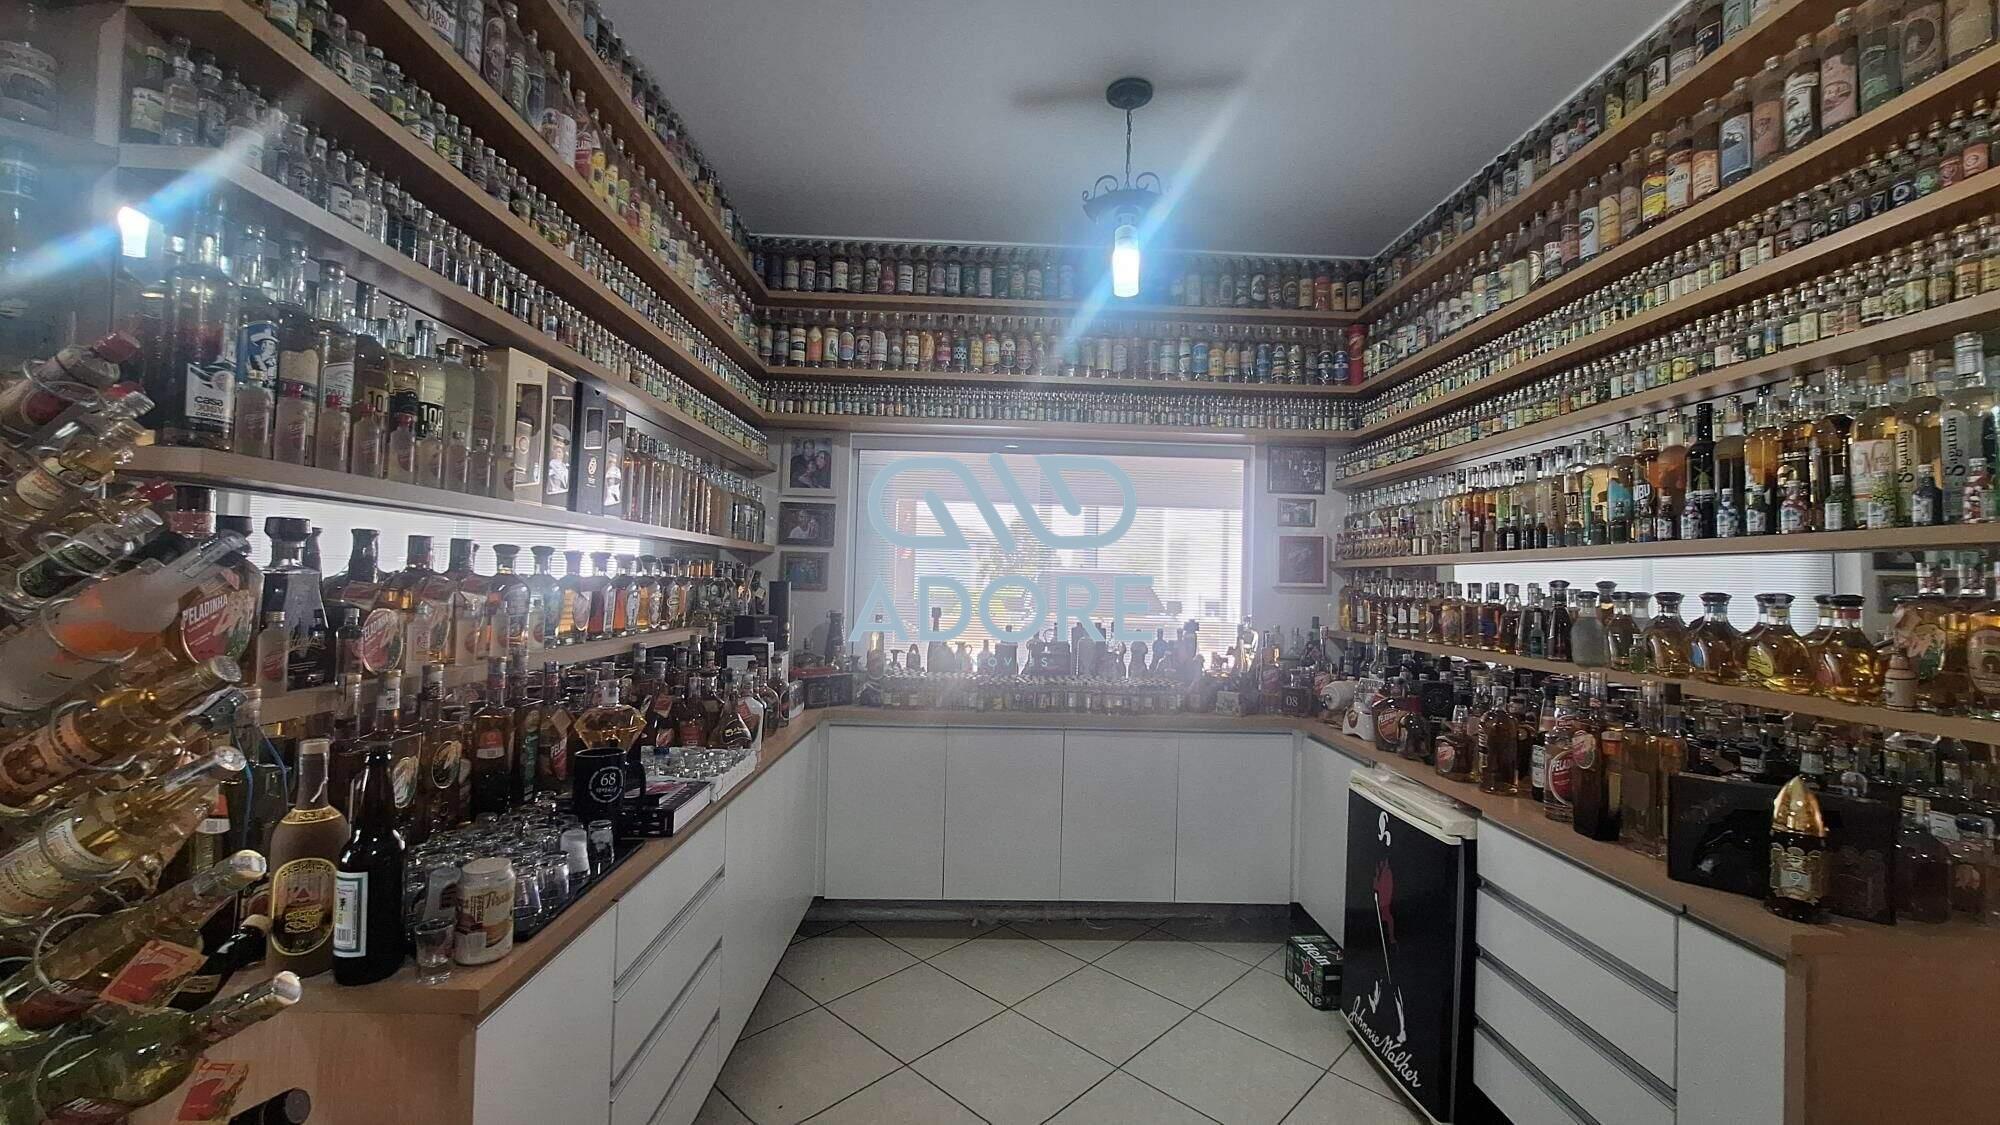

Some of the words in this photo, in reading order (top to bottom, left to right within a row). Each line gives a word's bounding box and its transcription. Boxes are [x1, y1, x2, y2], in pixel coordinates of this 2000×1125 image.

[1897, 429, 1914, 483] Sagatiba
[1944, 416, 1966, 477] Sagatiba
[181, 593, 228, 626] PELADINHA
[600, 772, 617, 786] 68
[1348, 995, 1382, 1047] Johnnie
[1381, 1035, 1421, 1088] Walker
